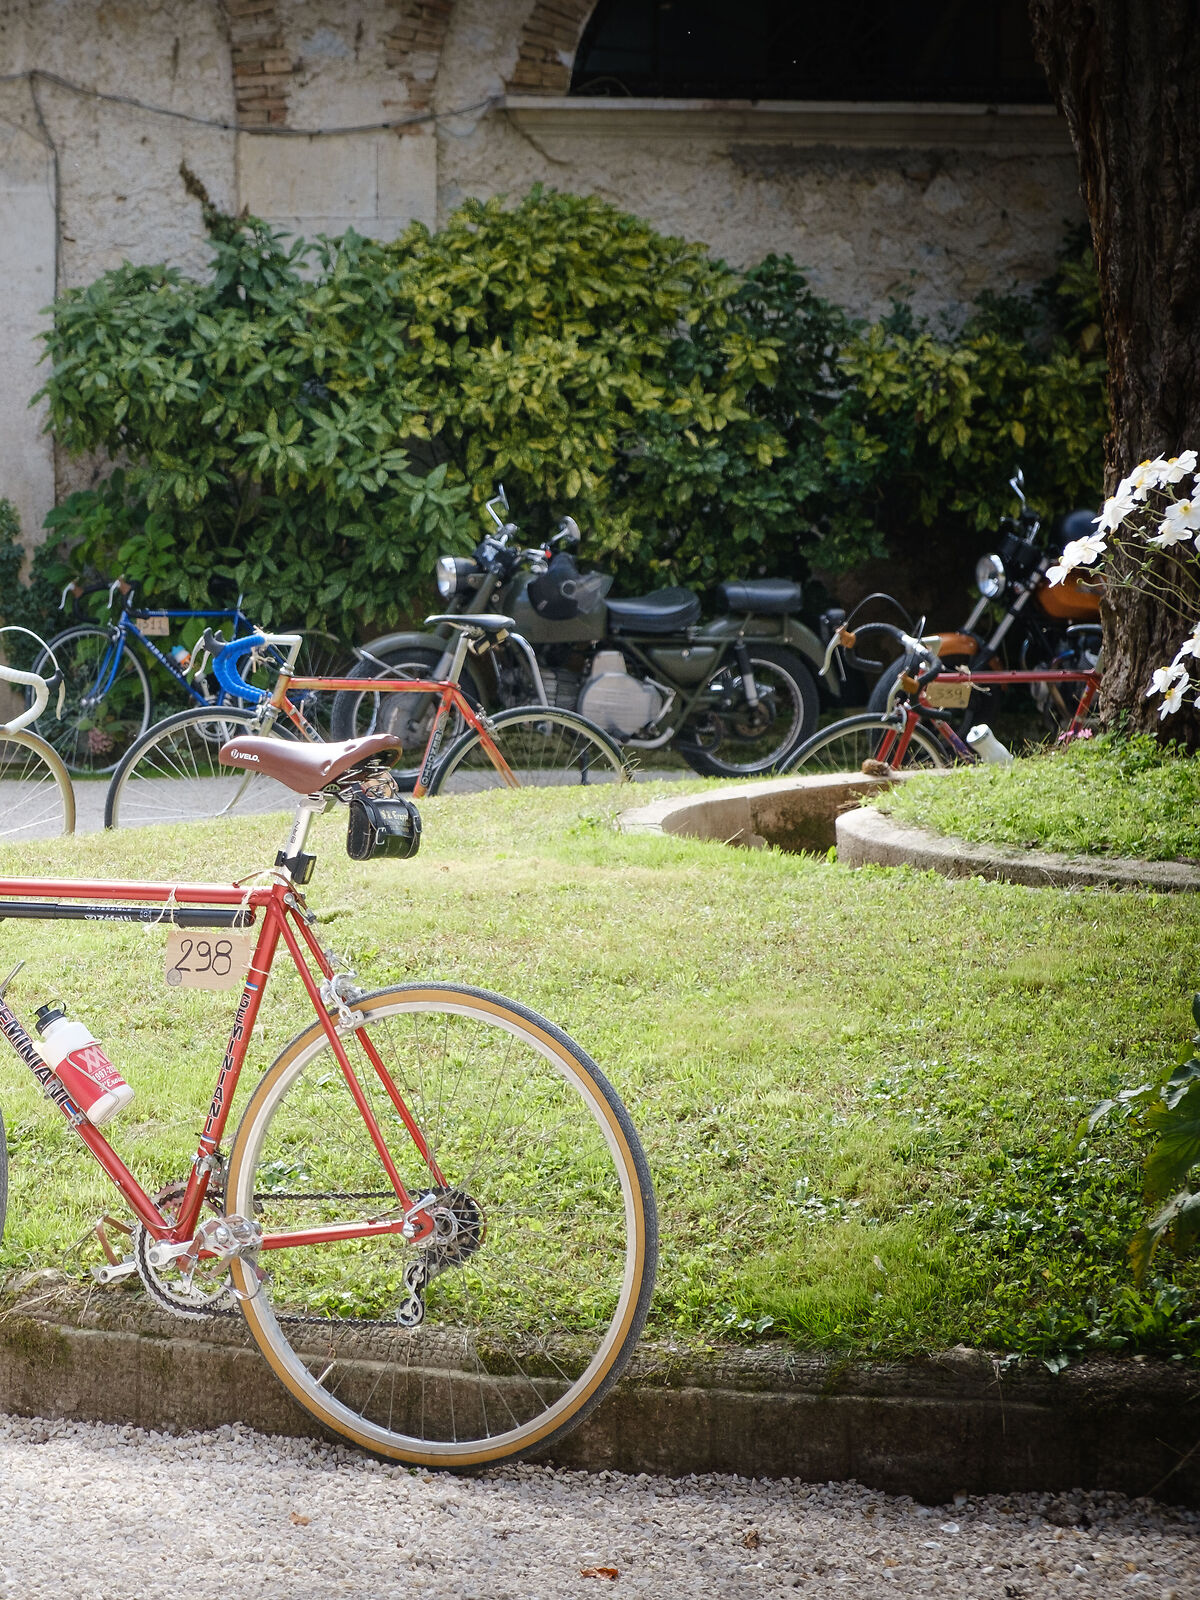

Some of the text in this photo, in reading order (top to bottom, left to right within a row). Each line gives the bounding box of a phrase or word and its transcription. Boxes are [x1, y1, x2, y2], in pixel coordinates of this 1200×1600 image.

[239, 752, 259, 761] VELO
[420, 731, 443, 786] BENOTTO
[174, 939, 233, 976] 298
[205, 993, 251, 1133] GEMINIANI
